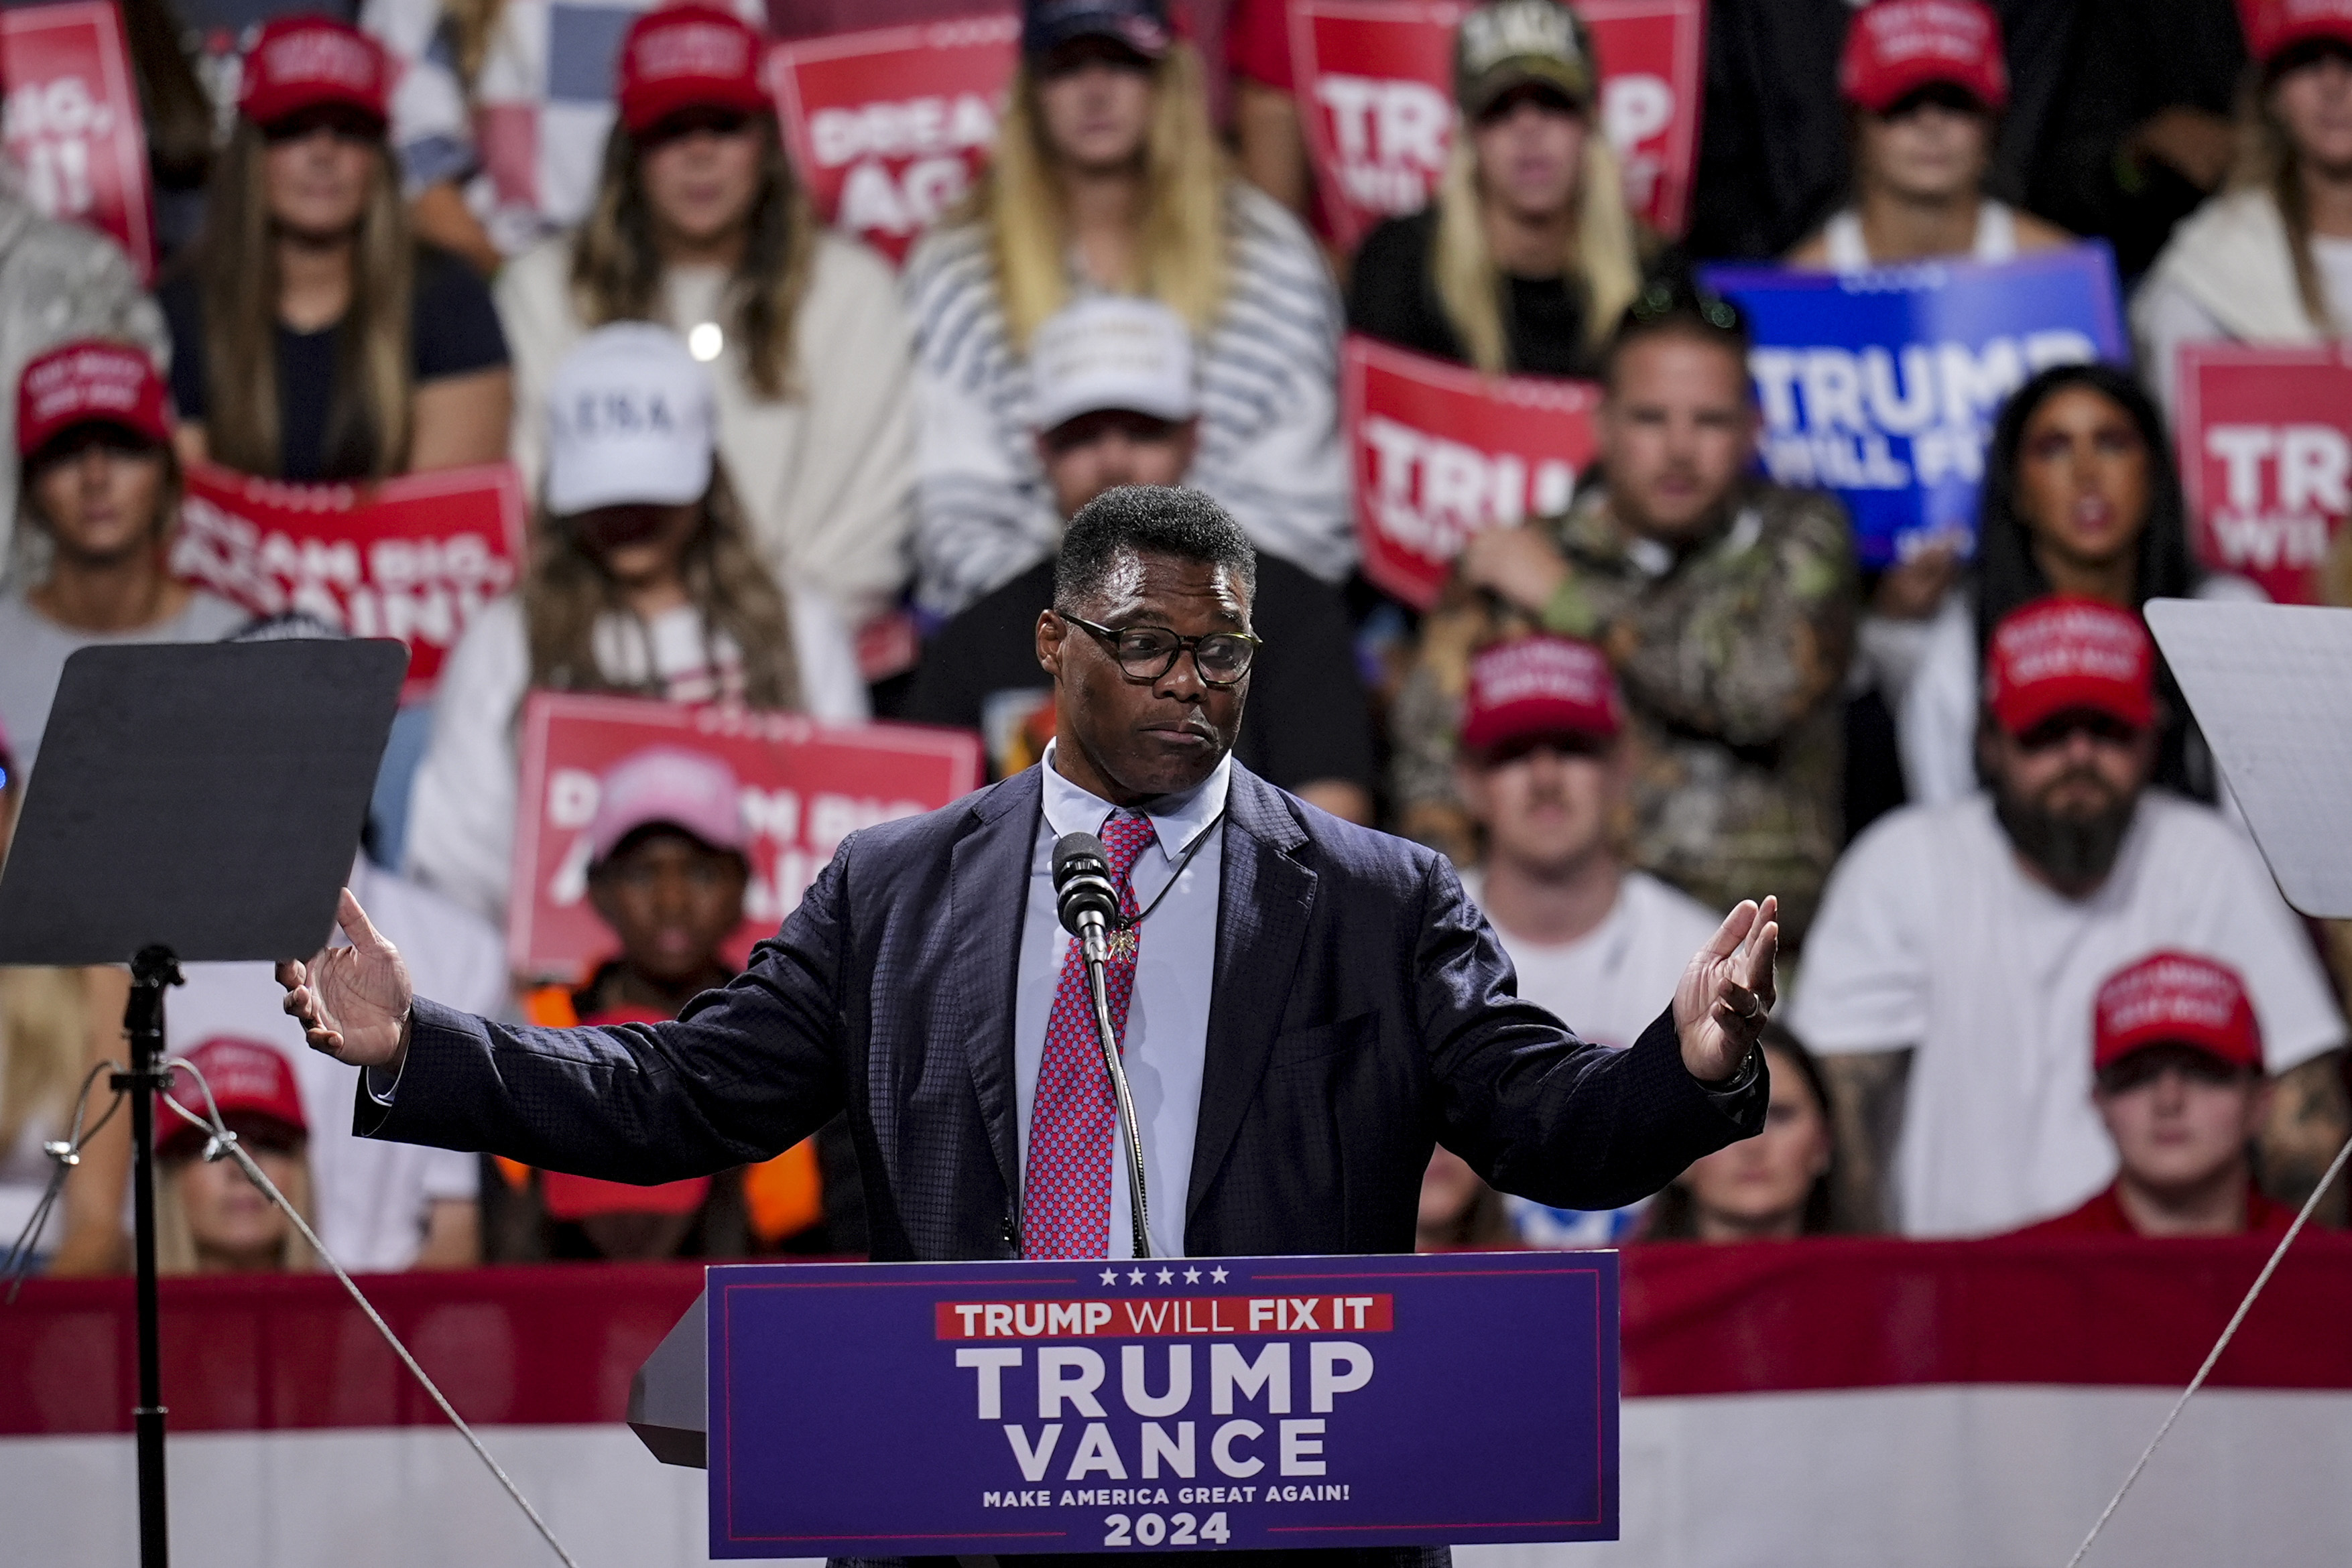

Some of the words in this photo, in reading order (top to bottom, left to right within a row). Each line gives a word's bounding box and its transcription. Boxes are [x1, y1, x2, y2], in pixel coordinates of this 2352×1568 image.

[810, 94, 1005, 168] DREA
[1315, 74, 1674, 173] TRP
[841, 159, 971, 238] AG
[1361, 414, 1576, 526] TRU
[955, 1302, 1113, 1336] TRUMP
[1125, 1300, 1235, 1333] WILL
[1249, 1298, 1320, 1331] FIX
[1333, 1297, 1374, 1329] IT
[955, 1341, 1375, 1419] TRUMP
[1003, 1419, 1327, 1482] VANCE
[983, 1490, 1051, 1508] MAKE
[1059, 1488, 1170, 1506] AMERICA
[1178, 1486, 1257, 1504] GREAT
[1265, 1484, 1350, 1502] AGAIN!
[1104, 1512, 1231, 1546] 2024
